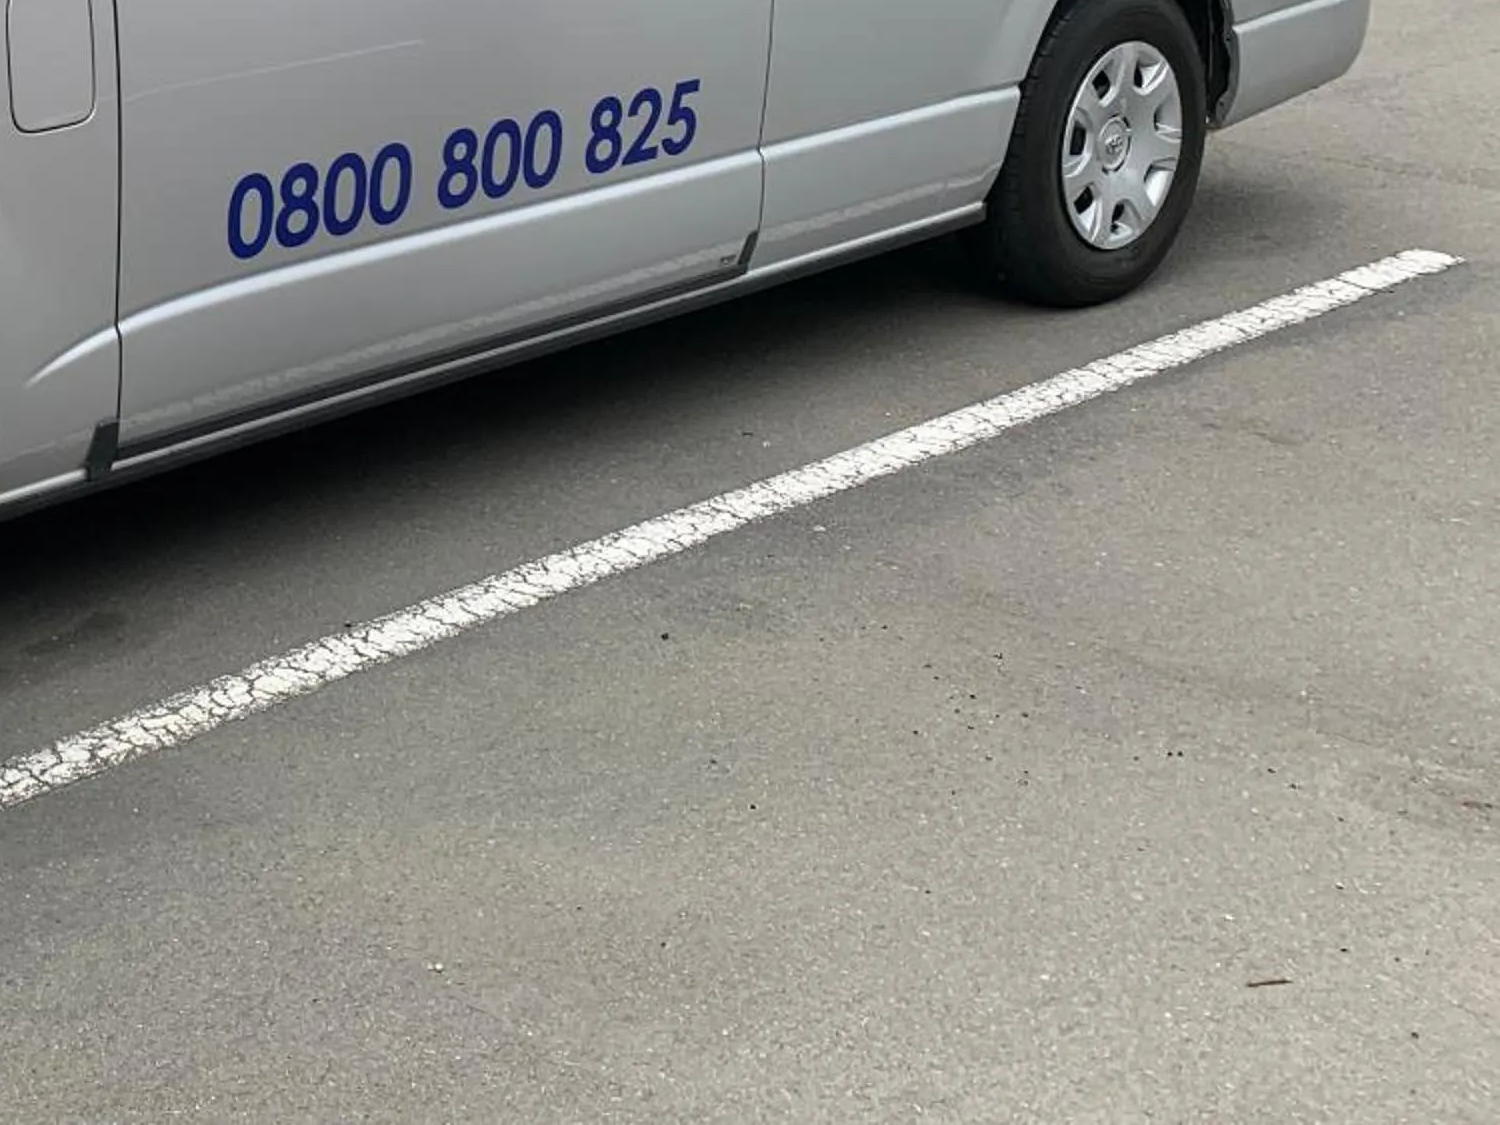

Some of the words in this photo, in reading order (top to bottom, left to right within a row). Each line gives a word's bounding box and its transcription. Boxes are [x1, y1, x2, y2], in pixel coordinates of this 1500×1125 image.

[227, 142, 412, 259] 0800
[437, 110, 562, 209] 800
[585, 79, 700, 174] 825
